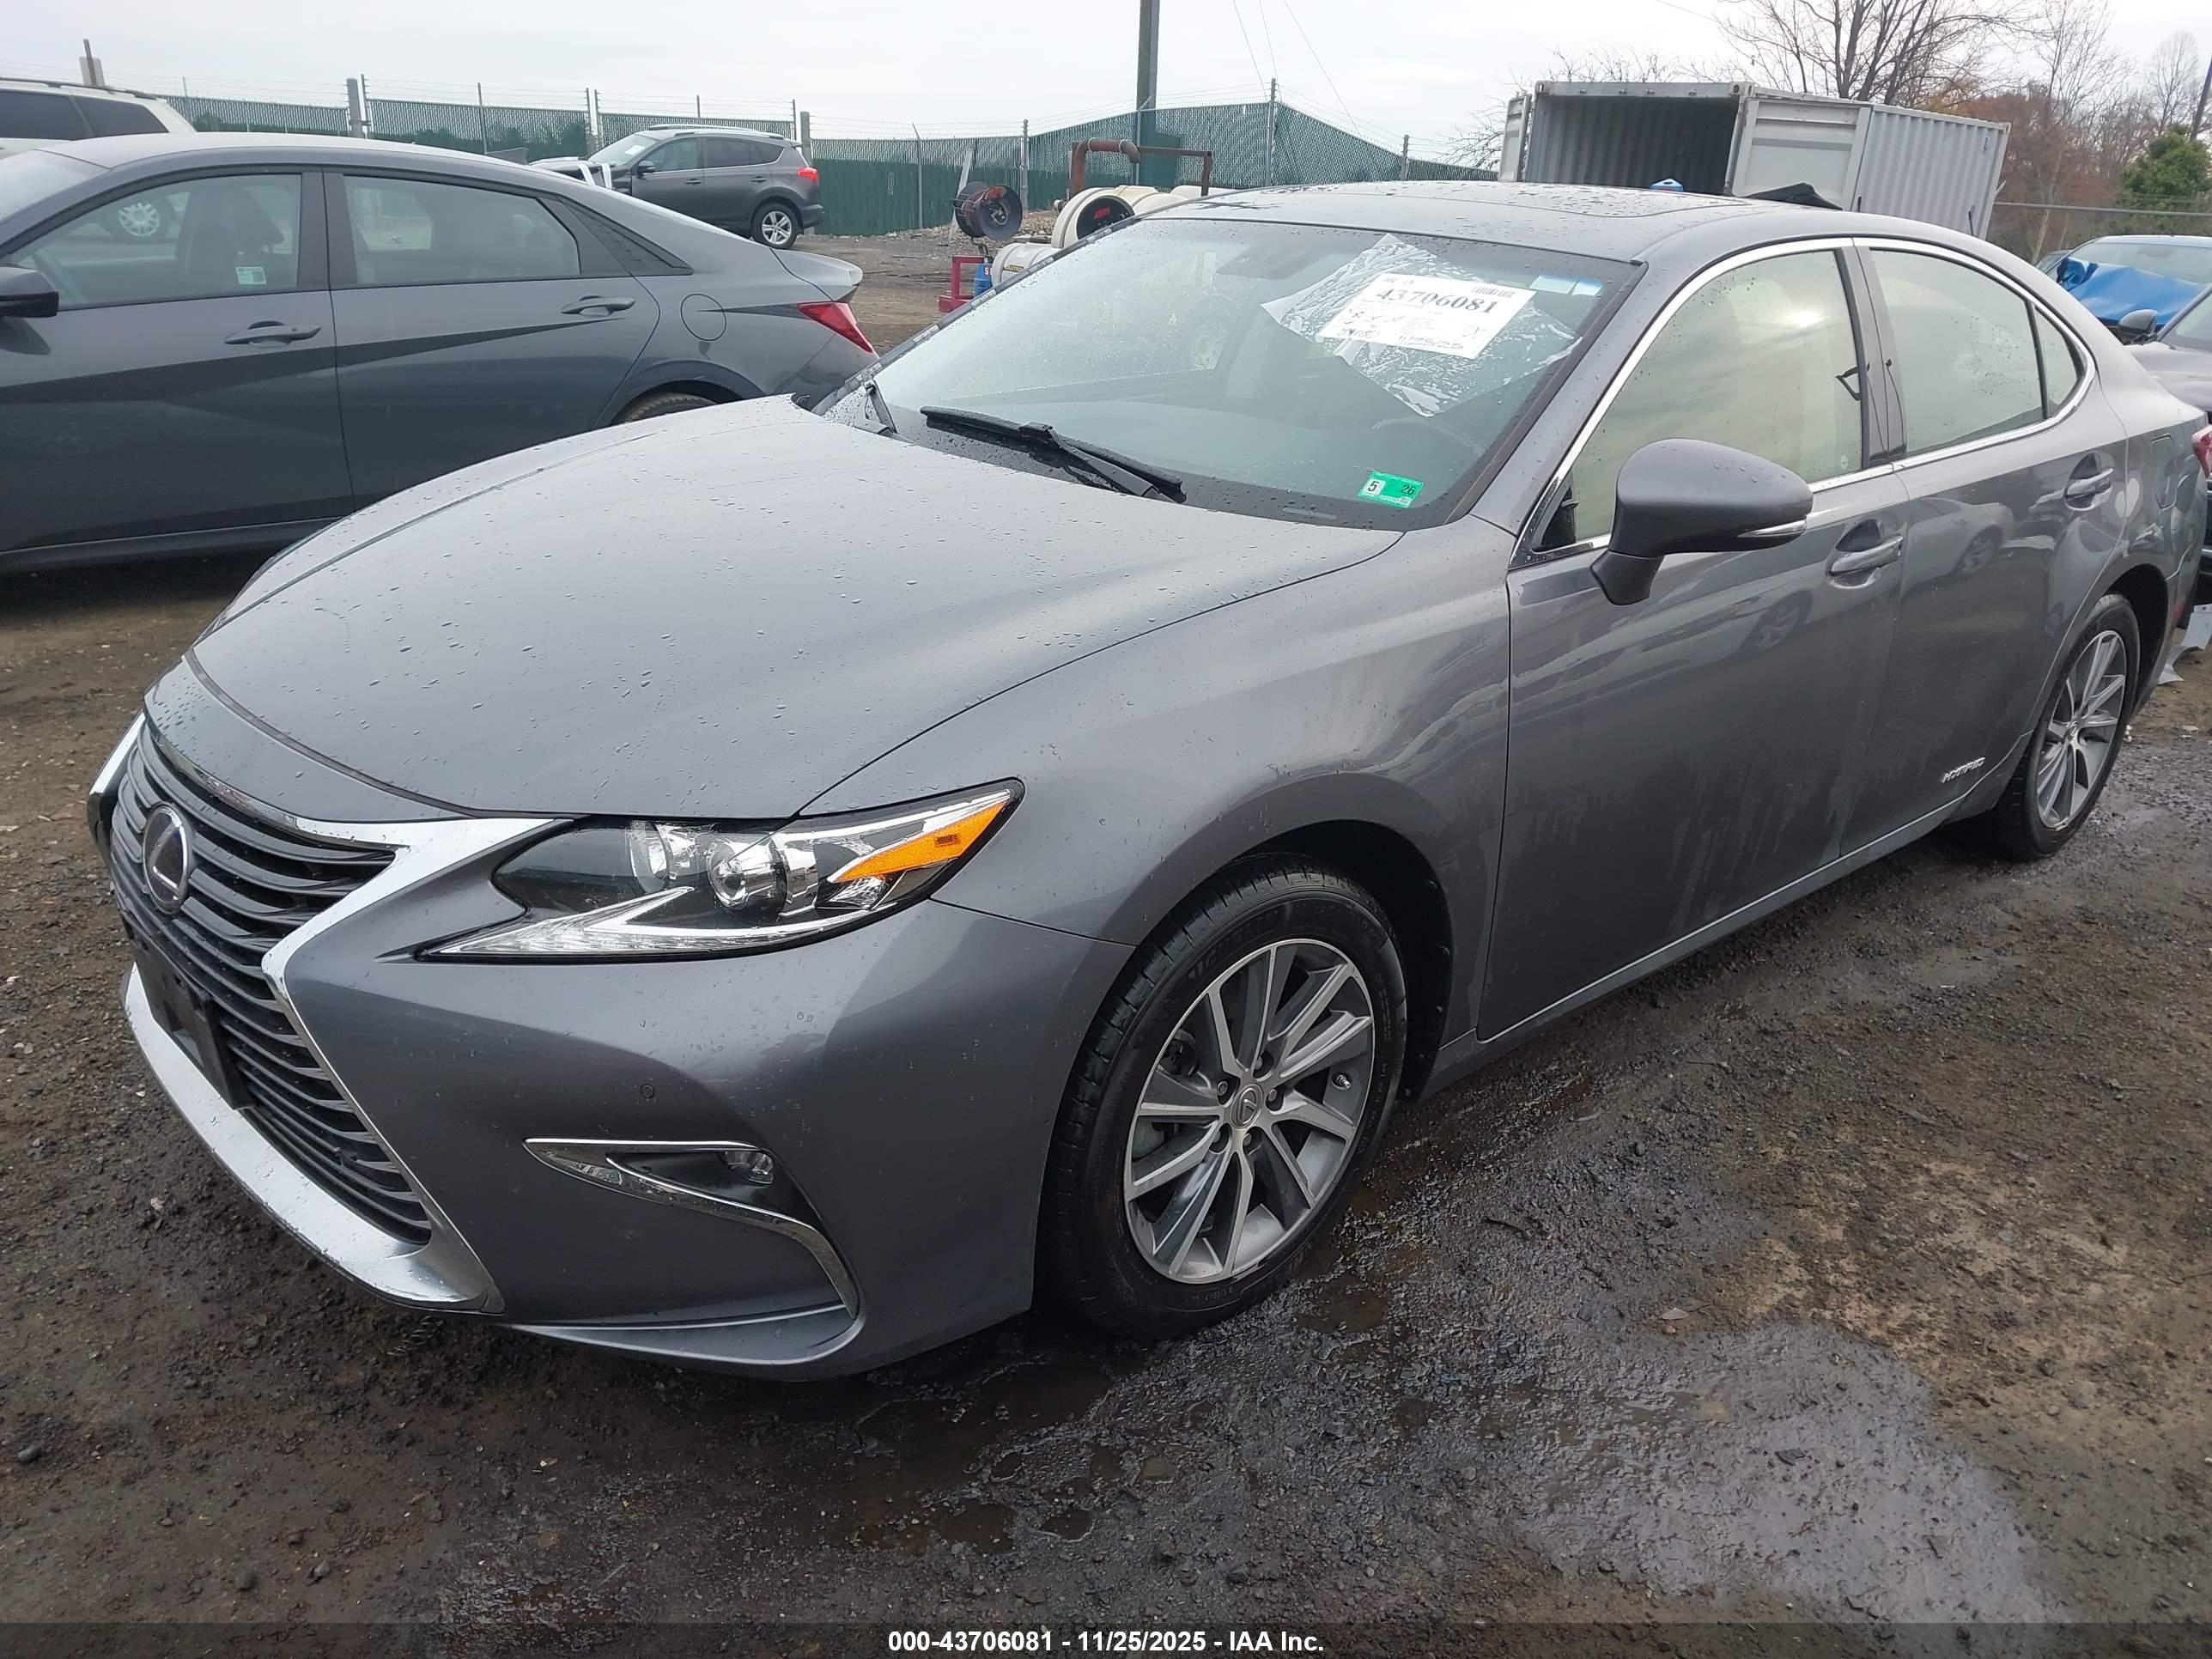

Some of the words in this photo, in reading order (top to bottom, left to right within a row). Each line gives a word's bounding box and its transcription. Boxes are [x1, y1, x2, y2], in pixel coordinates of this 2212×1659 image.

[1376, 288, 1498, 313] 43706081
[1367, 480, 1380, 492] 5
[1401, 483, 1417, 495] 26
